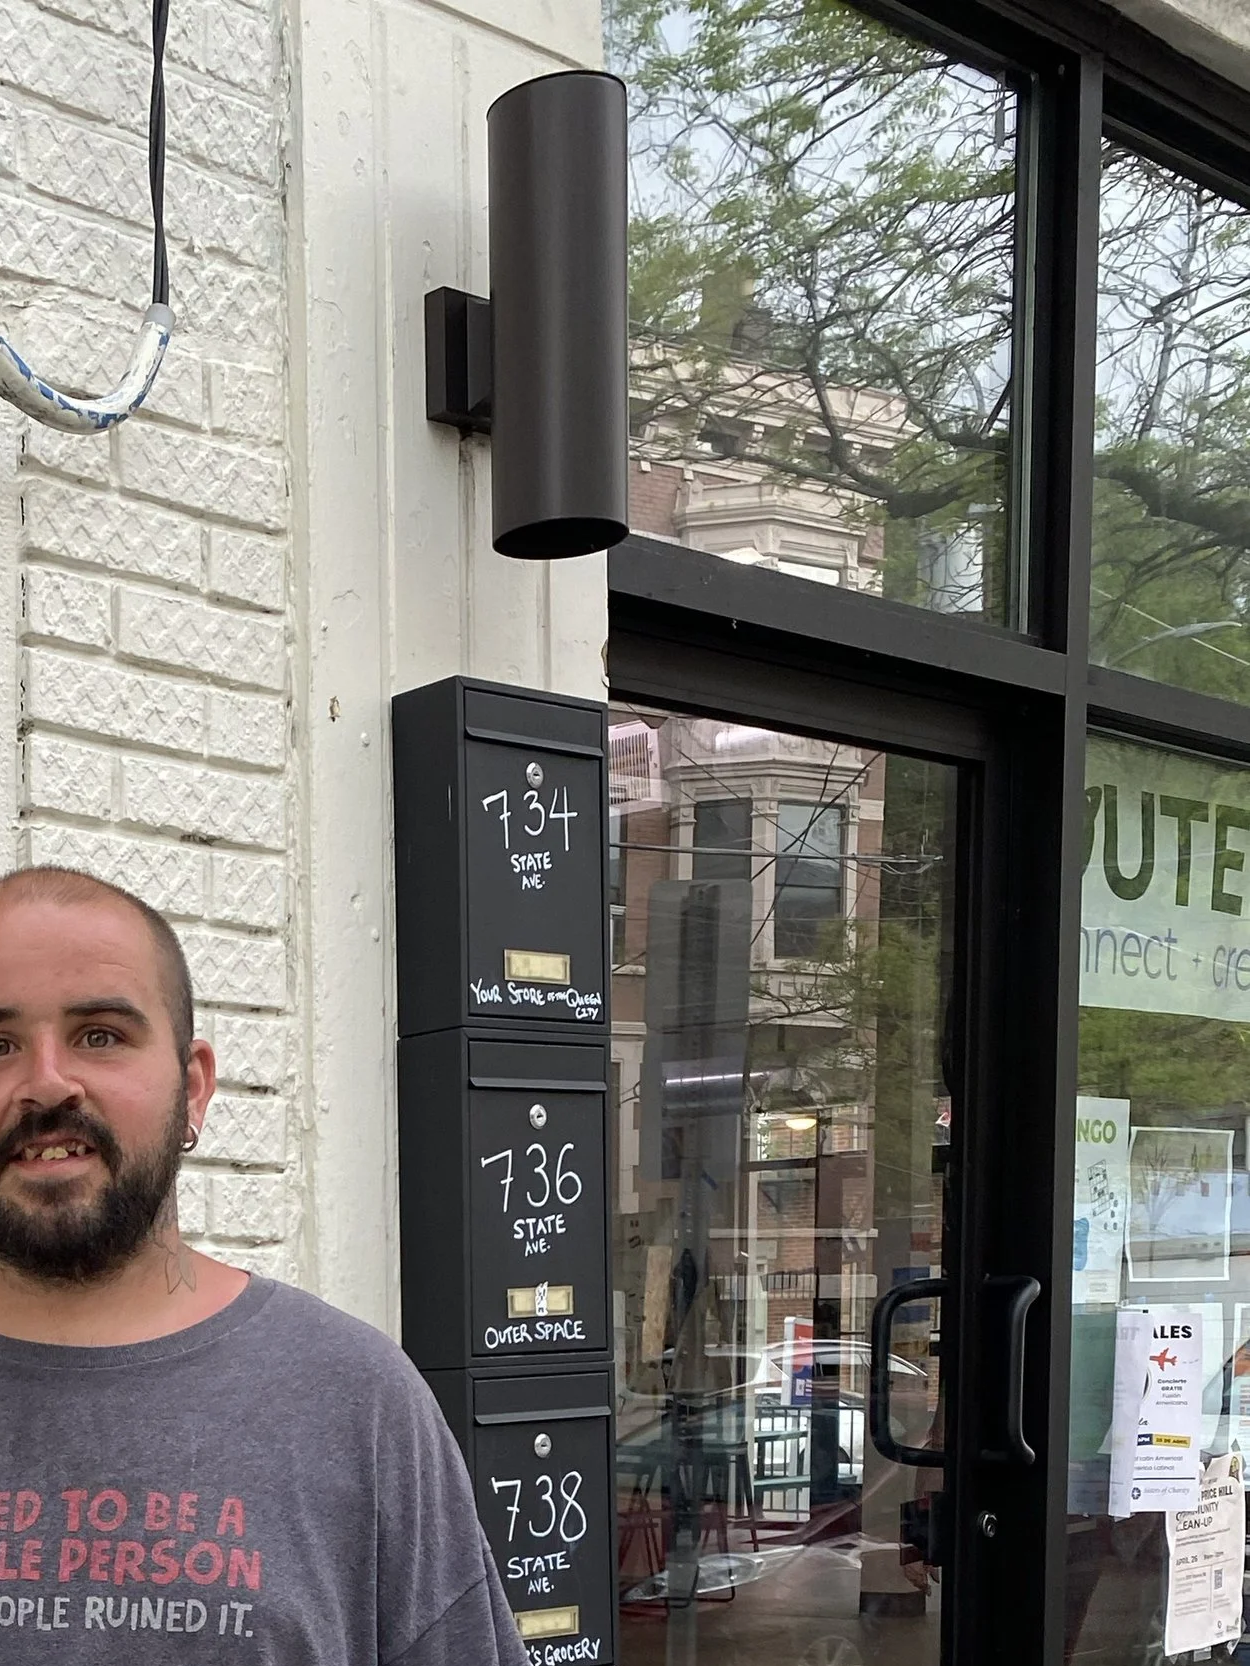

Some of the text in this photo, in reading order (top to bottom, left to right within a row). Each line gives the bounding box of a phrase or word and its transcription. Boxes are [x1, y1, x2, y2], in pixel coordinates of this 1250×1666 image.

[481, 785, 579, 851] 734
[510, 851, 553, 873] STATE
[521, 873, 546, 890] AVE.
[508, 982, 546, 1006] STORE
[566, 988, 602, 1007] QUEEN
[575, 1006, 599, 1021] CITY
[481, 1143, 582, 1213] 736
[513, 1213, 567, 1240] STATE
[524, 1239, 551, 1257] AVE.
[484, 1319, 586, 1349] OUTER SPACE
[61, 1489, 129, 1533] TO
[144, 1491, 199, 1533] BE
[216, 1496, 246, 1537] A
[490, 1470, 587, 1543] 738
[1176, 1501, 1219, 1521] CUNITY
[58, 1538, 263, 1590] PERSON
[507, 1551, 571, 1579] STATE
[526, 1577, 555, 1596] AVE.
[84, 1596, 208, 1634] RUINED
[219, 1599, 254, 1637] IT.
[545, 1637, 601, 1666] GROCERY
